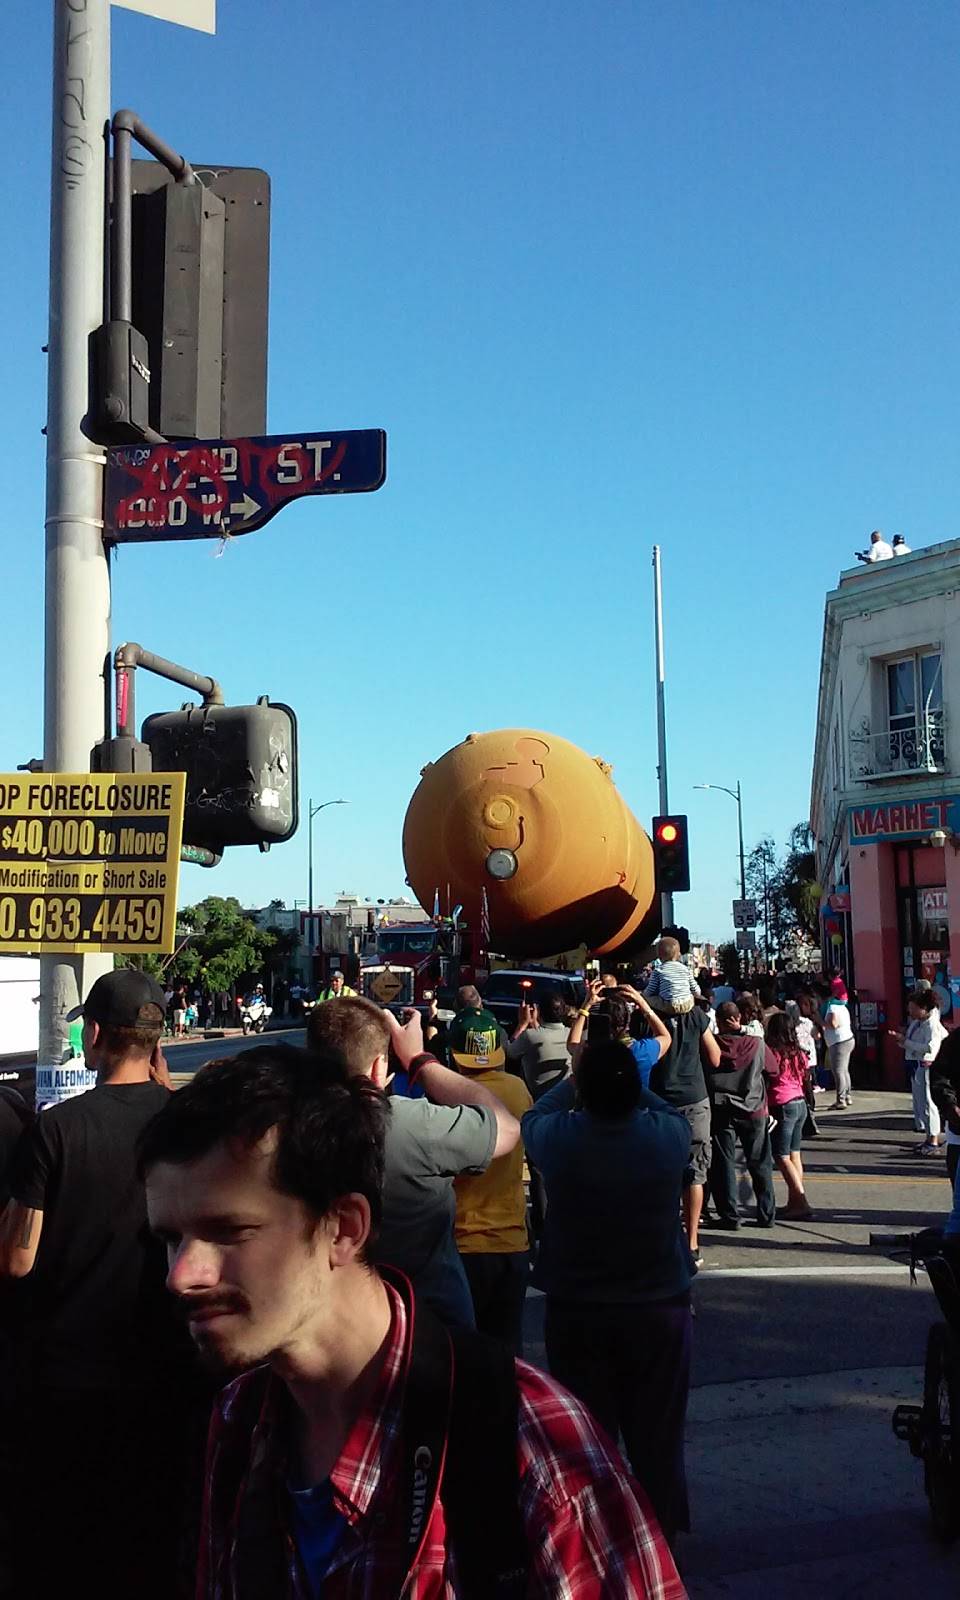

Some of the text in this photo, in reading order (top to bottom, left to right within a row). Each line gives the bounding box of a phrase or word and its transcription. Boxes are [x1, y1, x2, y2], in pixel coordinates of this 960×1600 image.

[276, 440, 341, 484] ST.
[28, 783, 172, 811] FORECLOSURE
[852, 802, 953, 837] MARKET
[2, 819, 96, 858] $40,000
[98, 829, 116, 855] to
[119, 827, 166, 856] Move
[0, 868, 167, 889] Modification or Short Sale
[736, 915, 755, 926] 35
[408, 1446, 432, 1543] Canon
